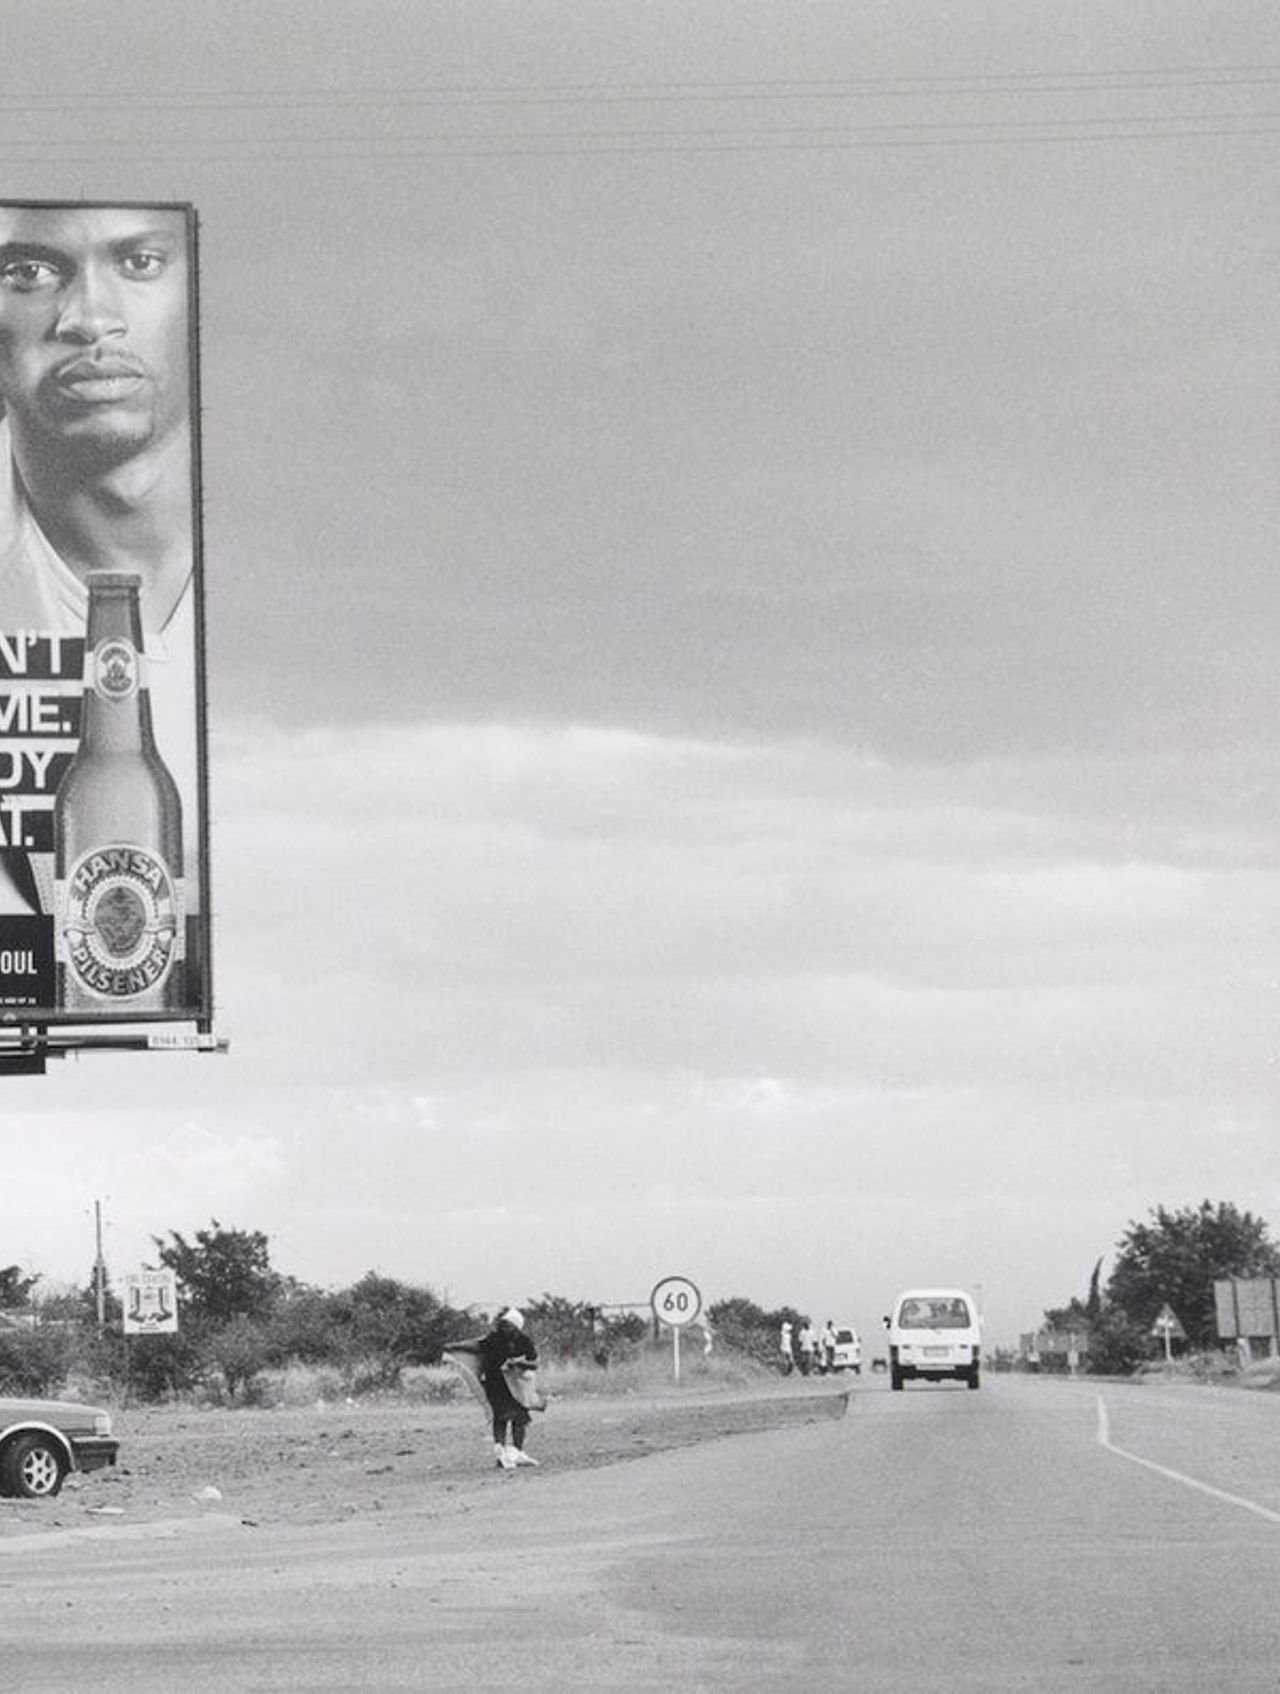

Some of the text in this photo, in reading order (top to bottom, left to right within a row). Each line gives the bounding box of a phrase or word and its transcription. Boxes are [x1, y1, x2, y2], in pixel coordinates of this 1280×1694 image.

[74, 850, 164, 892] HANSA
[72, 946, 168, 993] PILSENER
[663, 1291, 688, 1312] 60
